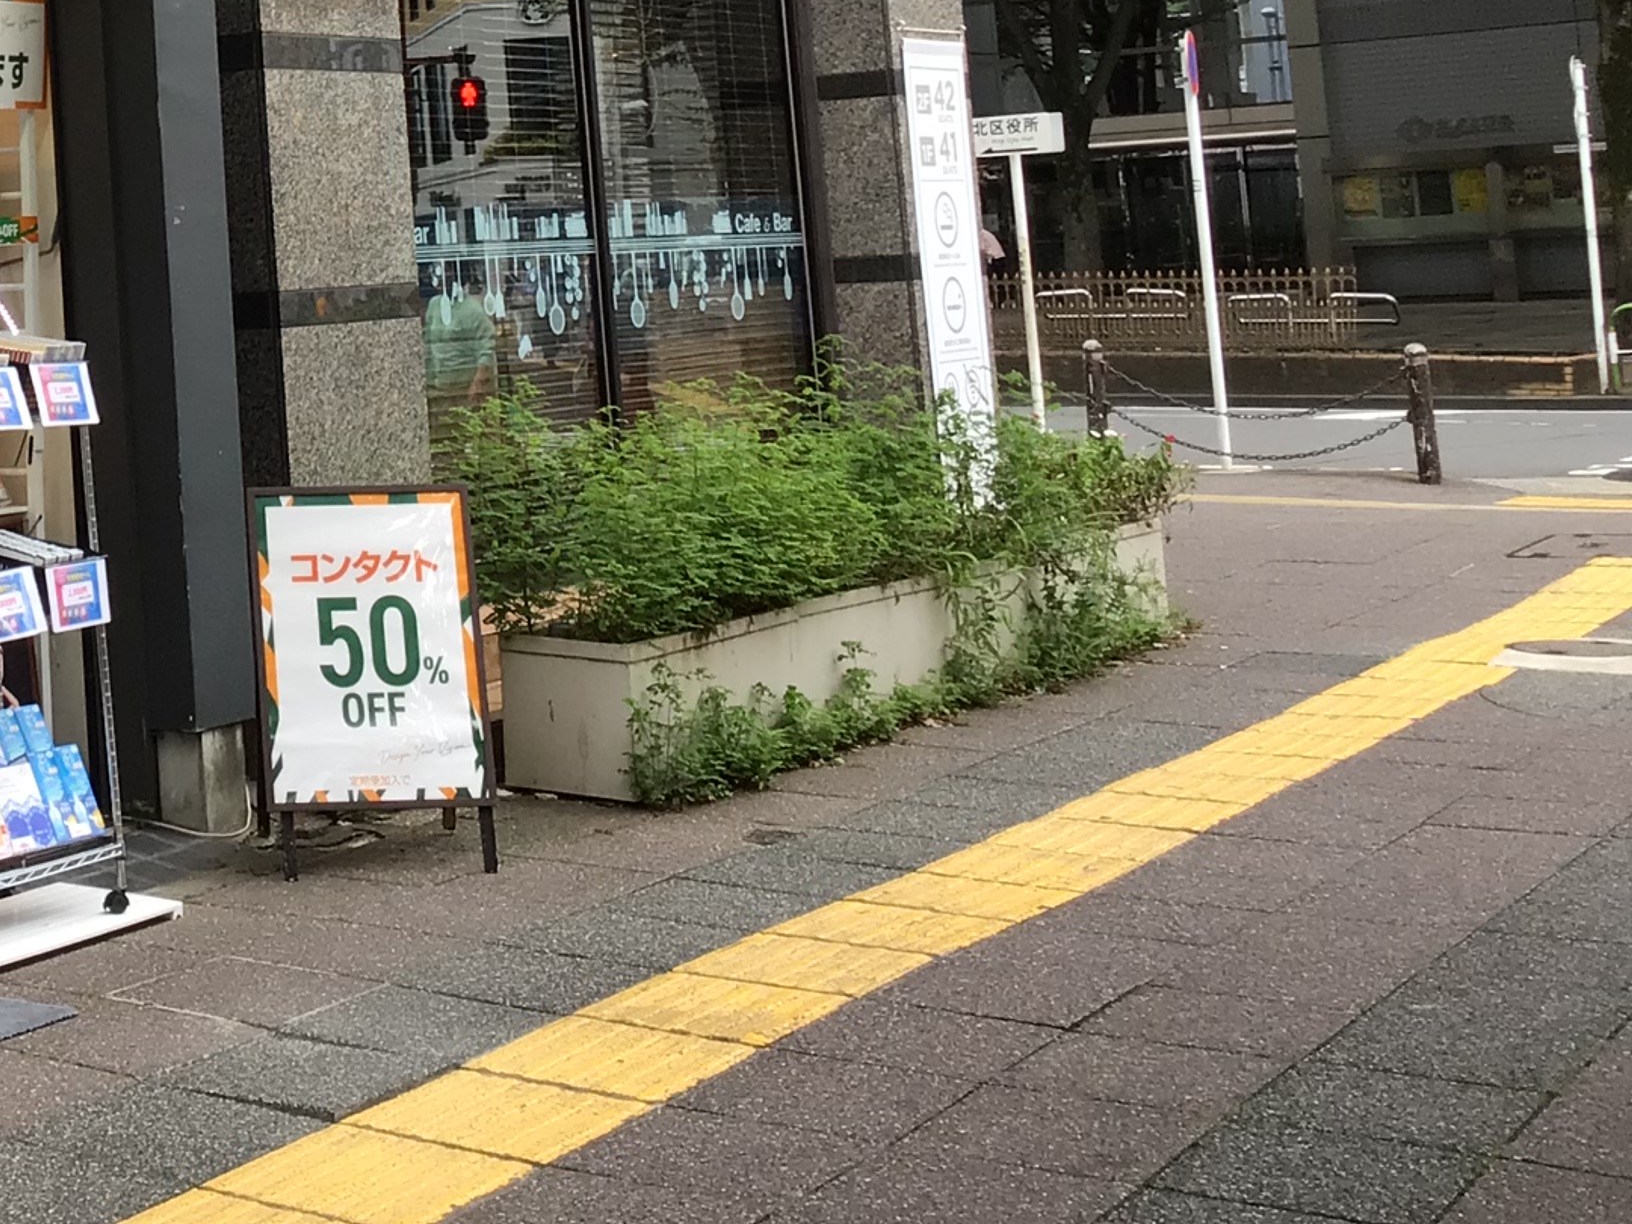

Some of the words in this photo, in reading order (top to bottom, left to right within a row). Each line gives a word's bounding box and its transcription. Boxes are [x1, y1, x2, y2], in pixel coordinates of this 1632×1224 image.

[934, 79, 956, 112] 42
[939, 131, 958, 163] 41
[735, 212, 762, 234] Cafe
[772, 212, 793, 232] Bar
[290, 549, 438, 585] コンタクト
[341, 691, 407, 728] OFF
